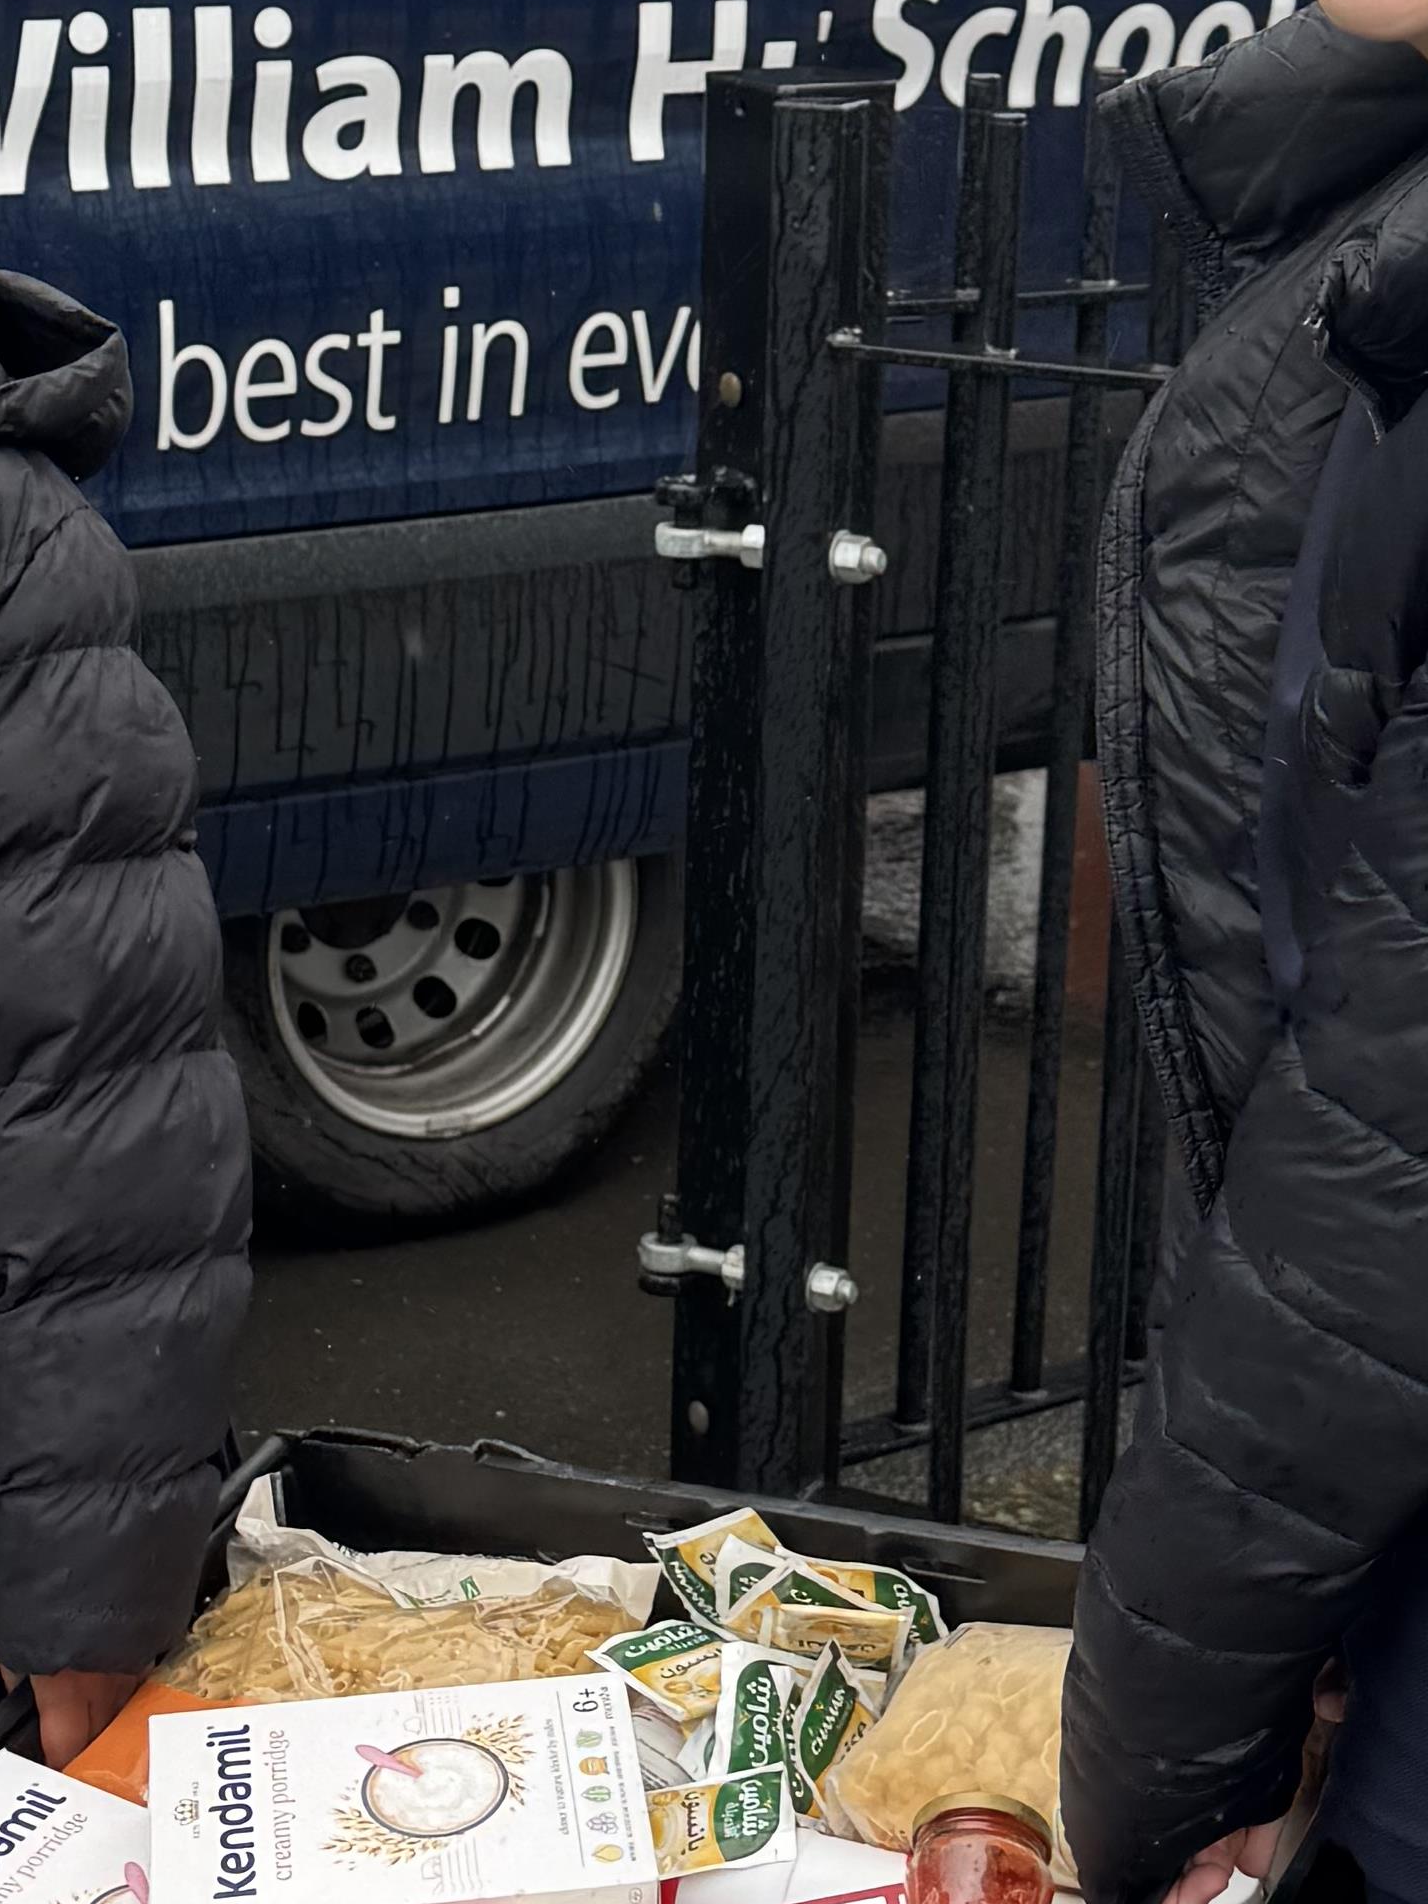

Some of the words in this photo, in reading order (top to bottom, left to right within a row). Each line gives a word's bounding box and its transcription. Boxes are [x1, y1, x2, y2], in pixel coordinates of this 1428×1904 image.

[157, 299, 402, 451] best
[439, 286, 529, 424] in
[569, 305, 700, 410] ev
[572, 1687, 599, 1713] 6+
[263, 1729, 296, 1804] porridge
[16, 1811, 88, 1881] porridge
[273, 1808, 296, 1881] creamy
